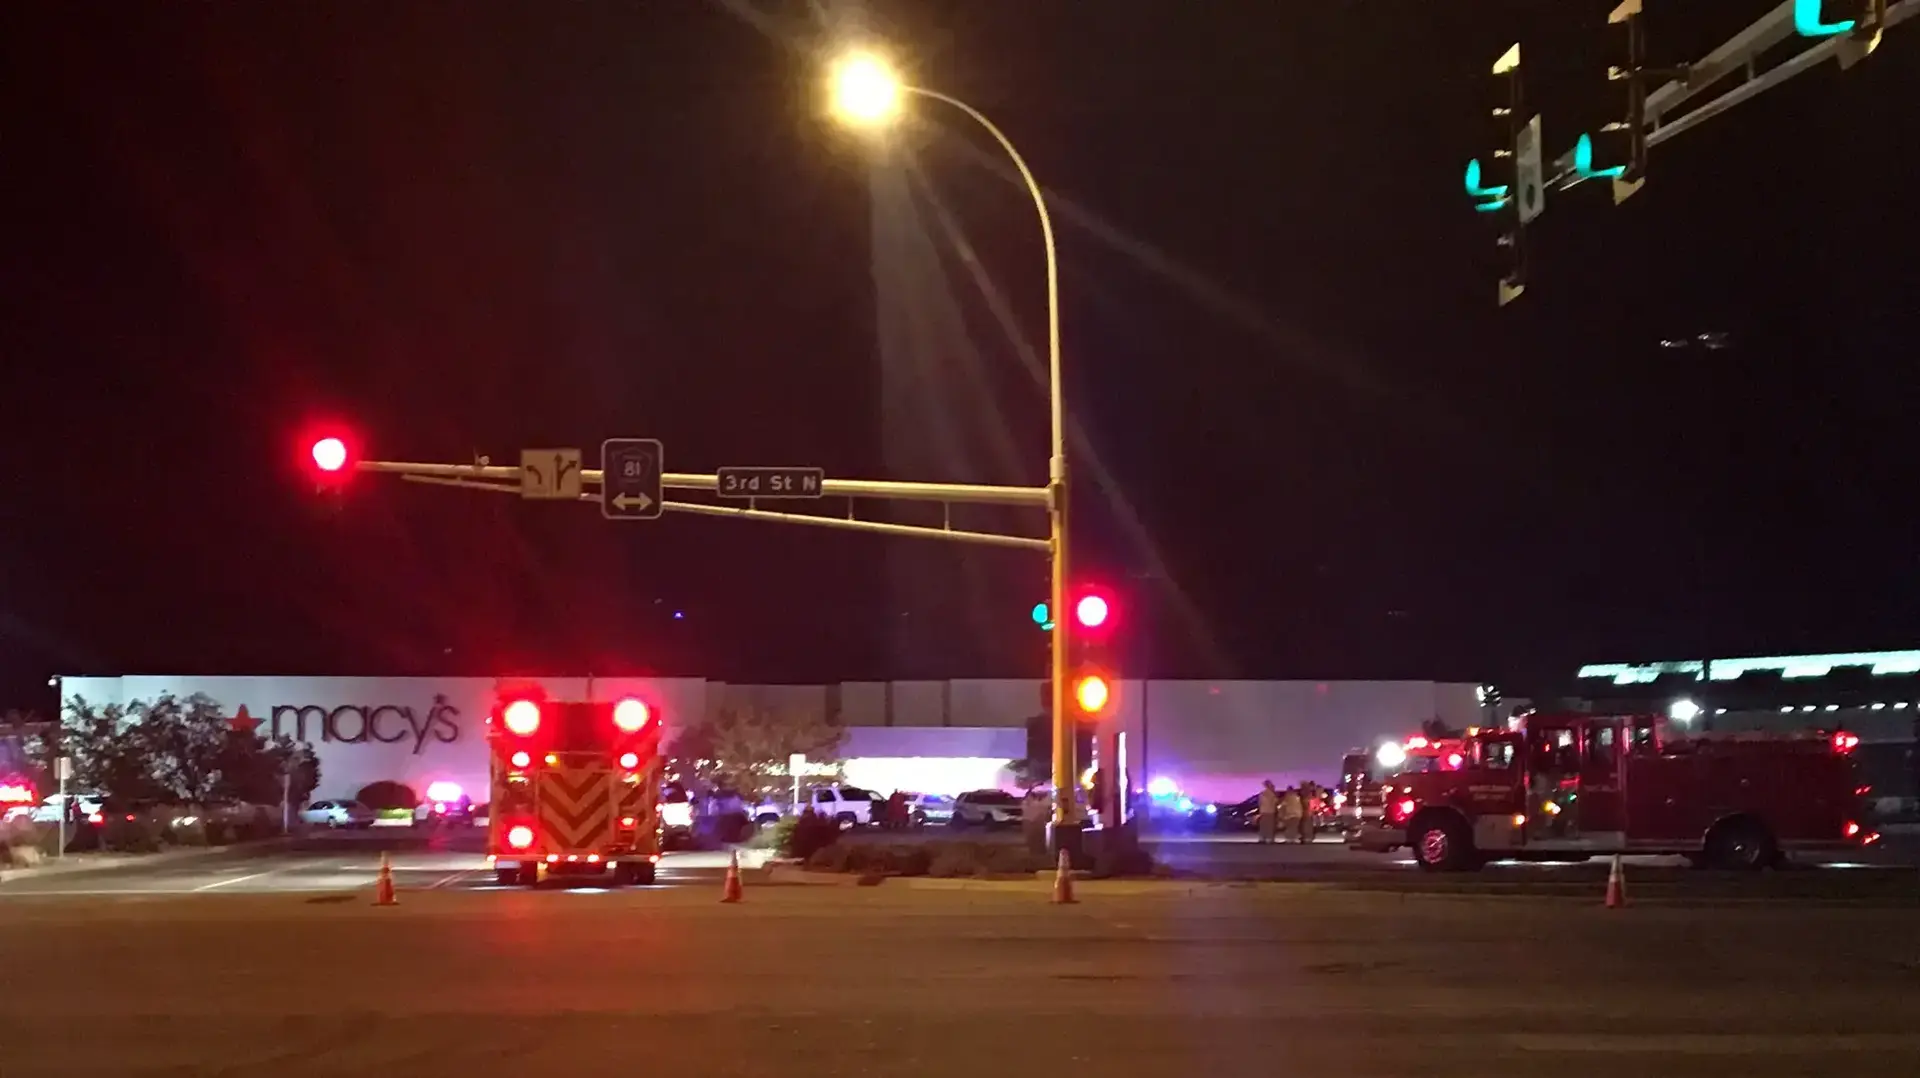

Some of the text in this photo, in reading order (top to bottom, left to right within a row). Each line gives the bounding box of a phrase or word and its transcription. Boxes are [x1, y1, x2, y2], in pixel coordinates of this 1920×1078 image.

[624, 460, 641, 476] 81
[726, 474, 816, 491] 3rd St N
[271, 694, 460, 755] macy's
